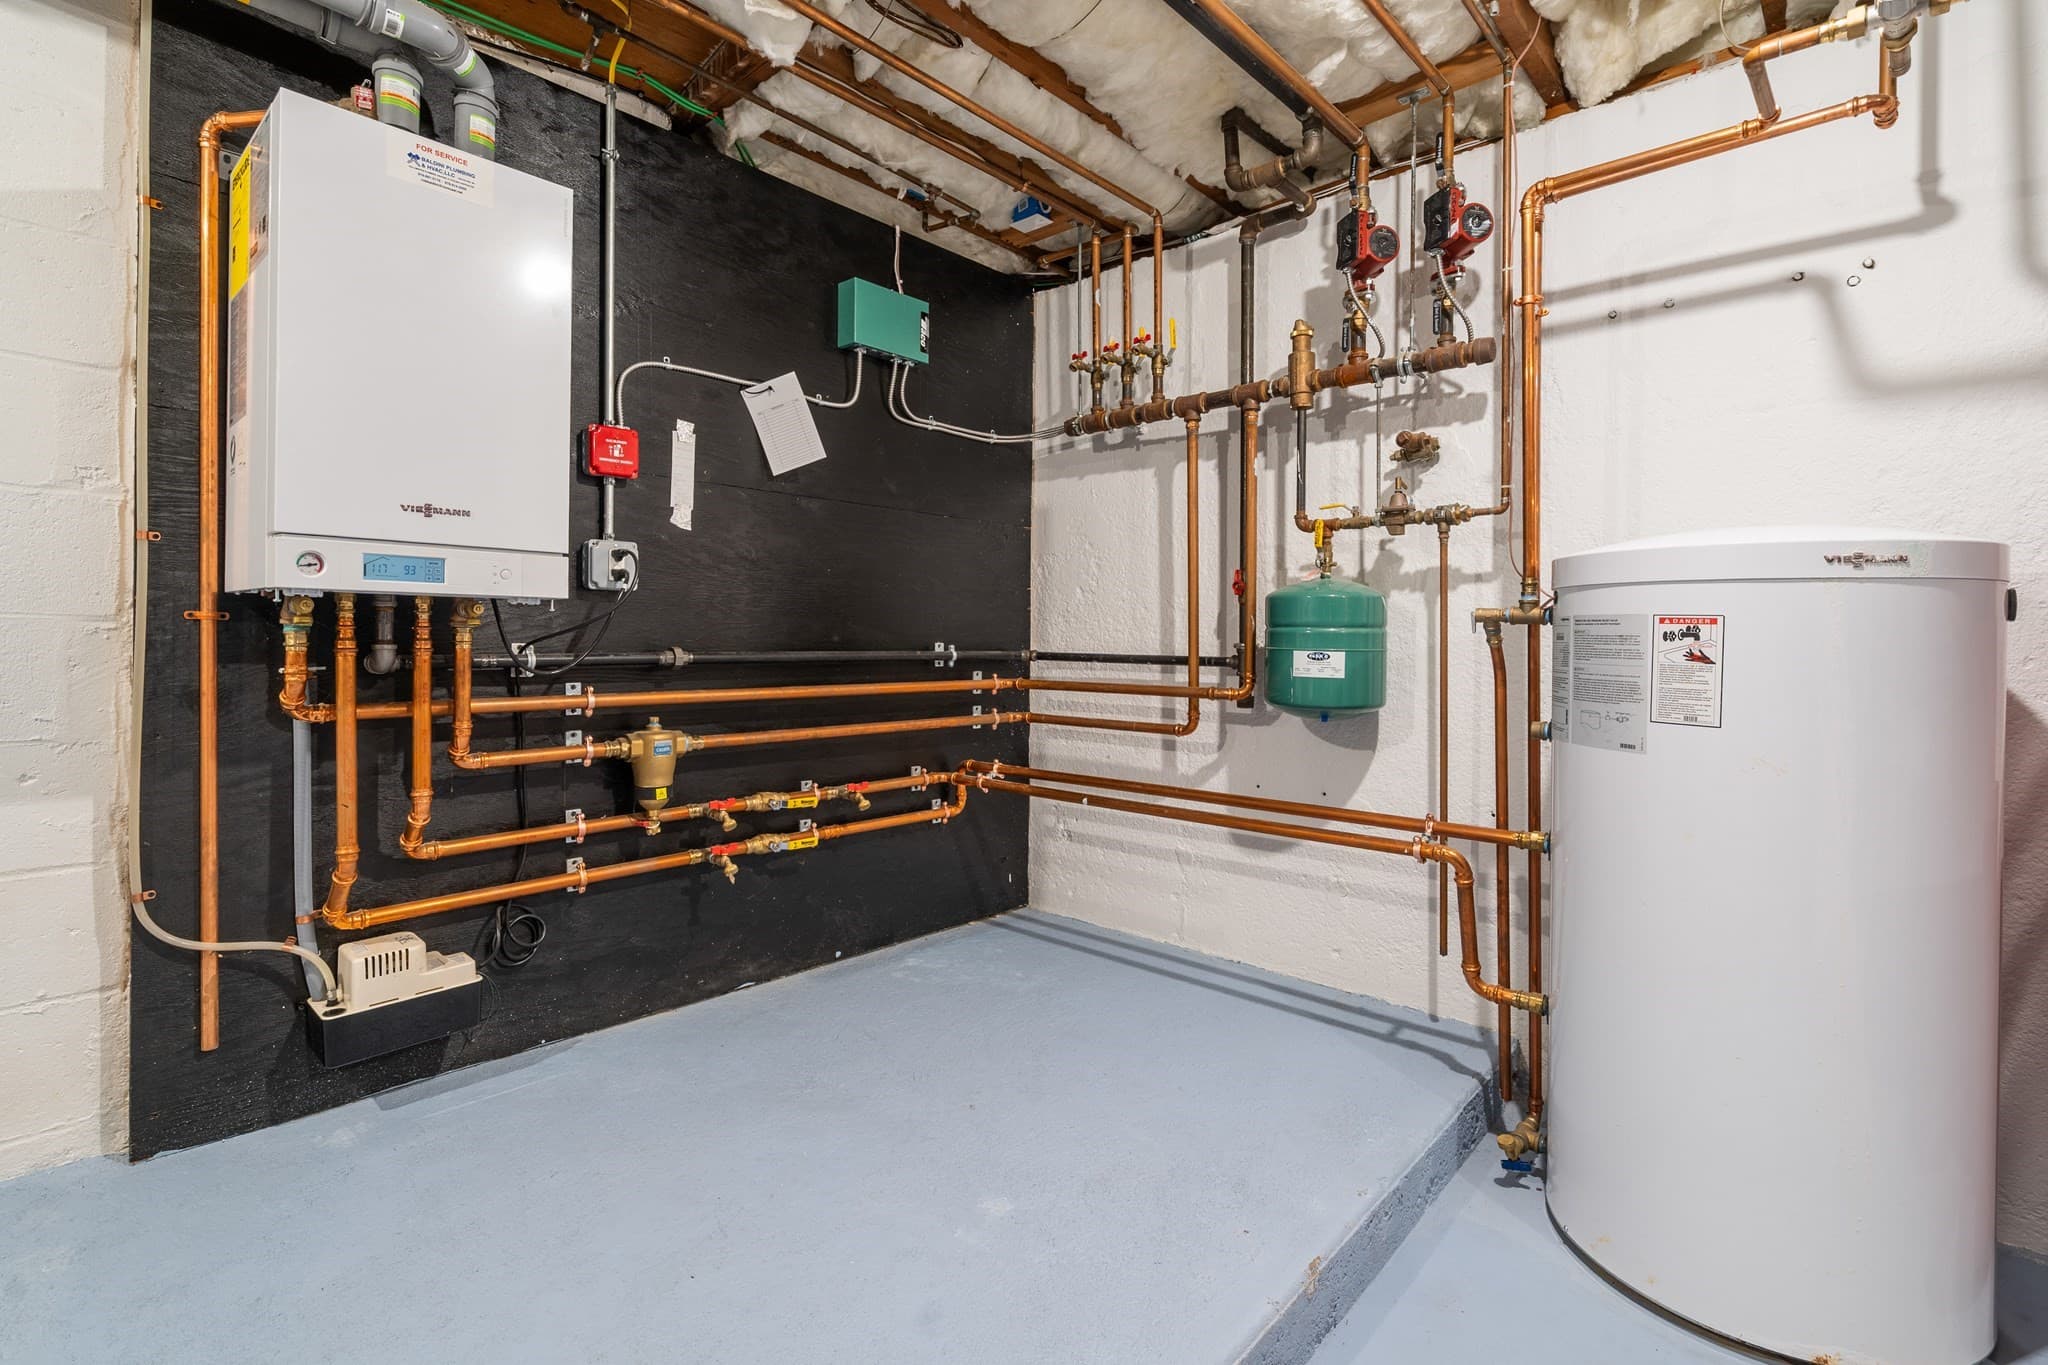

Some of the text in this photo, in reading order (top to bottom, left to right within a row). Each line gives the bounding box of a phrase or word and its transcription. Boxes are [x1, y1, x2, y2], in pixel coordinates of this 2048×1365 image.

[416, 143, 469, 166] FOR SERVICE
[404, 565, 417, 576] 93
